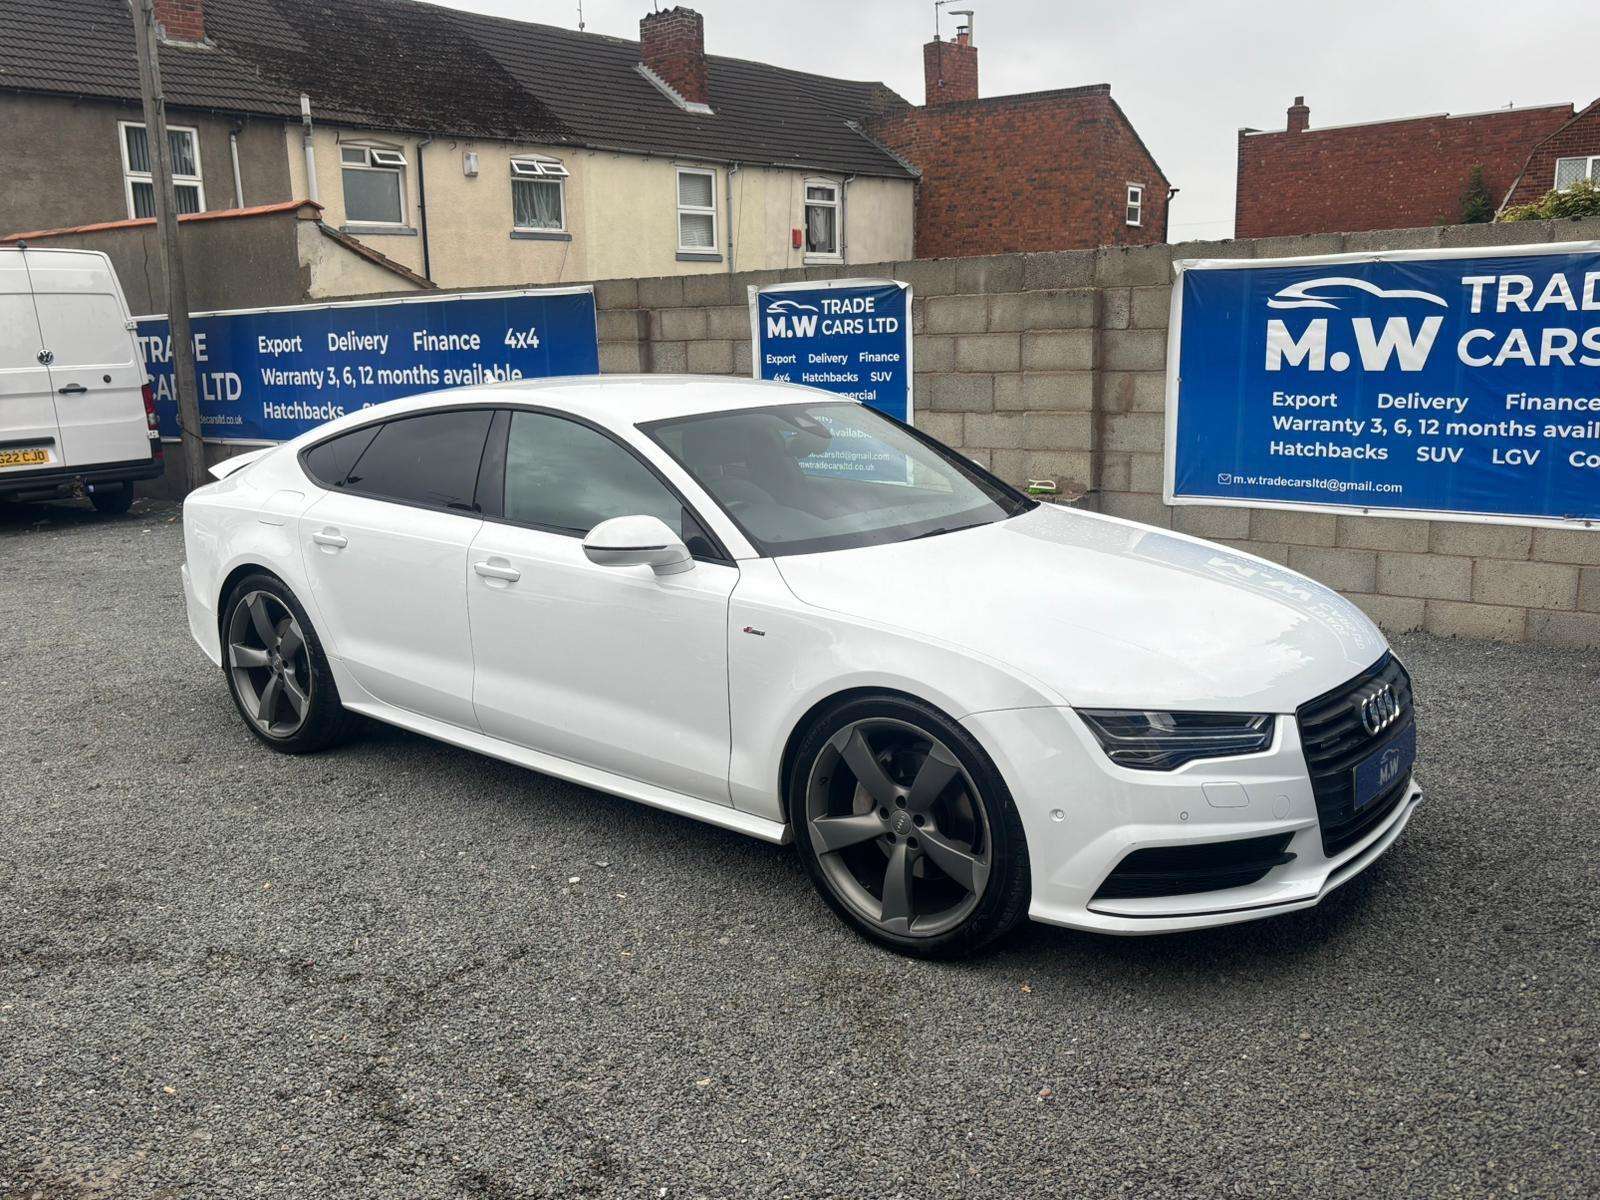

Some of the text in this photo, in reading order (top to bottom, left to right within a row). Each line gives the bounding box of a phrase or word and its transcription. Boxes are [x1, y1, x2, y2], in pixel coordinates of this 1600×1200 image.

[821, 297, 875, 314] TRADE
[767, 315, 818, 338] M.W
[822, 317, 899, 335] CARS LTD
[258, 327, 539, 357] Export Delivery Finance 4x4
[1265, 316, 1444, 372] M.W
[1457, 326, 1600, 367] CARS
[766, 352, 900, 365] Export Delivery Finance
[202, 373, 242, 400] LTD
[261, 367, 324, 389] Warranty
[327, 366, 340, 388] 3,
[343, 366, 356, 388] 6,
[358, 366, 374, 385] 12
[377, 364, 439, 386] months
[773, 371, 892, 383] 4x4 Hatchbacks SUV
[263, 401, 345, 420] Hatchbacks
[1272, 391, 1600, 414] Export Delivery Finance
[1272, 416, 1600, 438] Warranty 3, 6, 12 months avail
[1270, 441, 1600, 468] Hatchbacks SUV LGV Co
[1233, 474, 1403, 494] m.w.tradecarsltd@gmail.com
